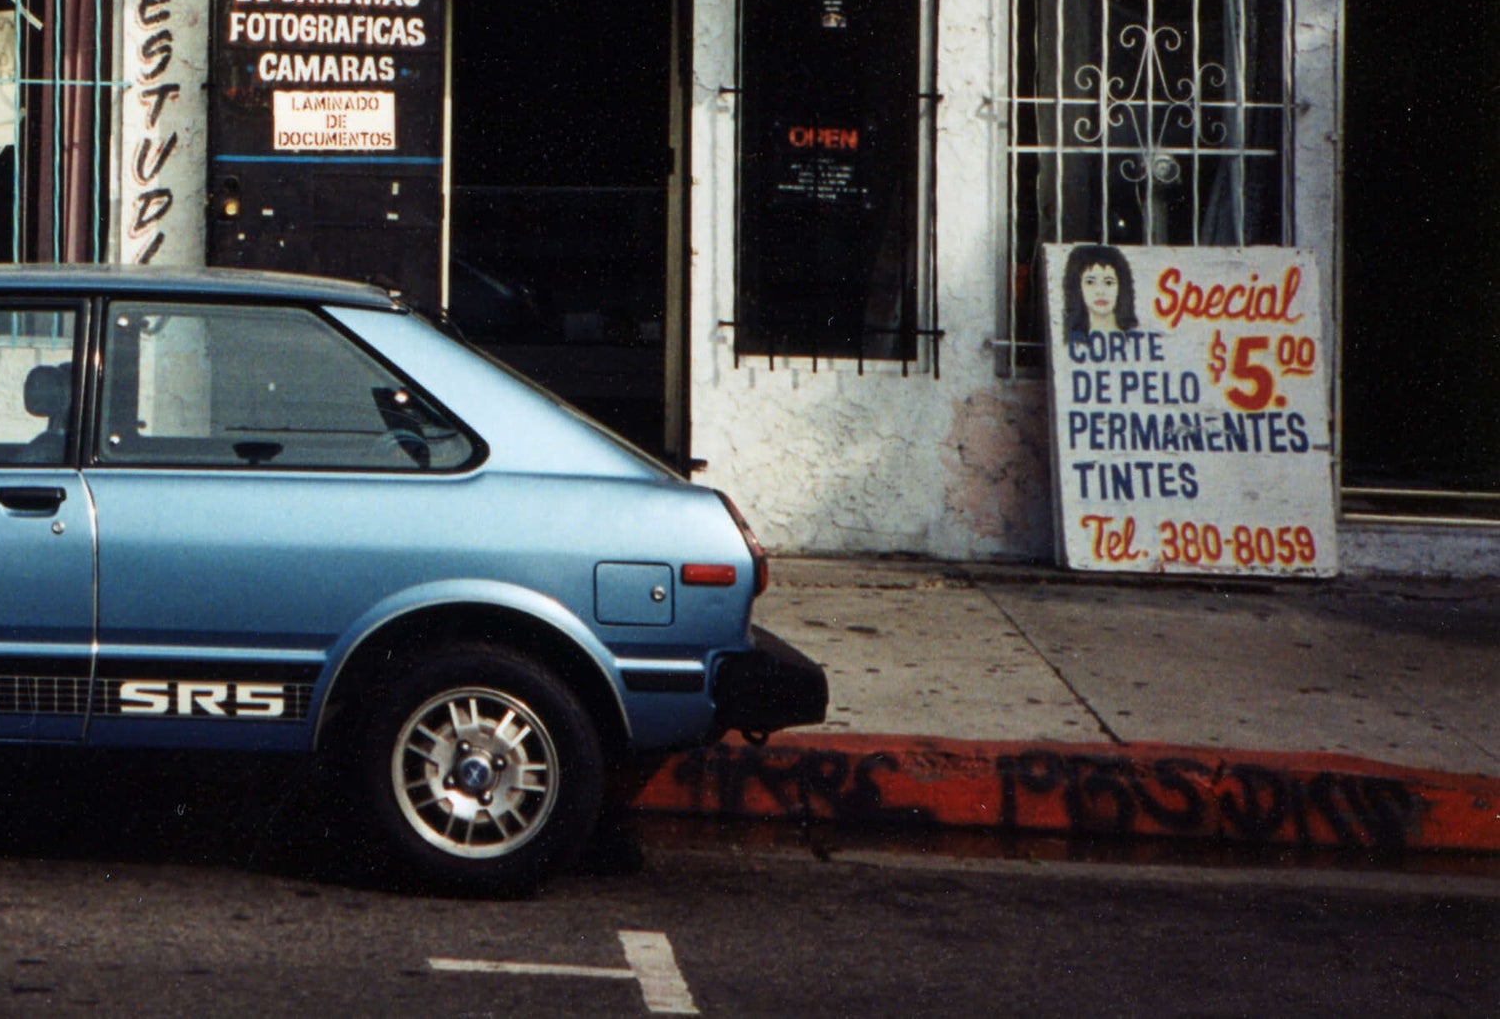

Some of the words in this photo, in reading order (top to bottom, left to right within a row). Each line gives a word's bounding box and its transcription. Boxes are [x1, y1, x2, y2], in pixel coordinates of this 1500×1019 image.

[230, 12, 426, 47] FOTOGRAFICAS
[259, 52, 395, 83] CAMARAS
[291, 96, 380, 112] LAMINADO
[326, 114, 347, 130] DE
[789, 127, 858, 150] OPEN
[278, 132, 393, 147] DOCUMENTOS
[1154, 266, 1303, 328] Special
[1068, 331, 1165, 364] CORTE
[1072, 370, 1112, 404] DE
[1120, 371, 1200, 404] PELO
[1068, 410, 1309, 453] PERMANENTES
[1072, 462, 1199, 501] TINTES
[1160, 520, 1316, 565] 380-8059
[120, 682, 285, 717] SR5
